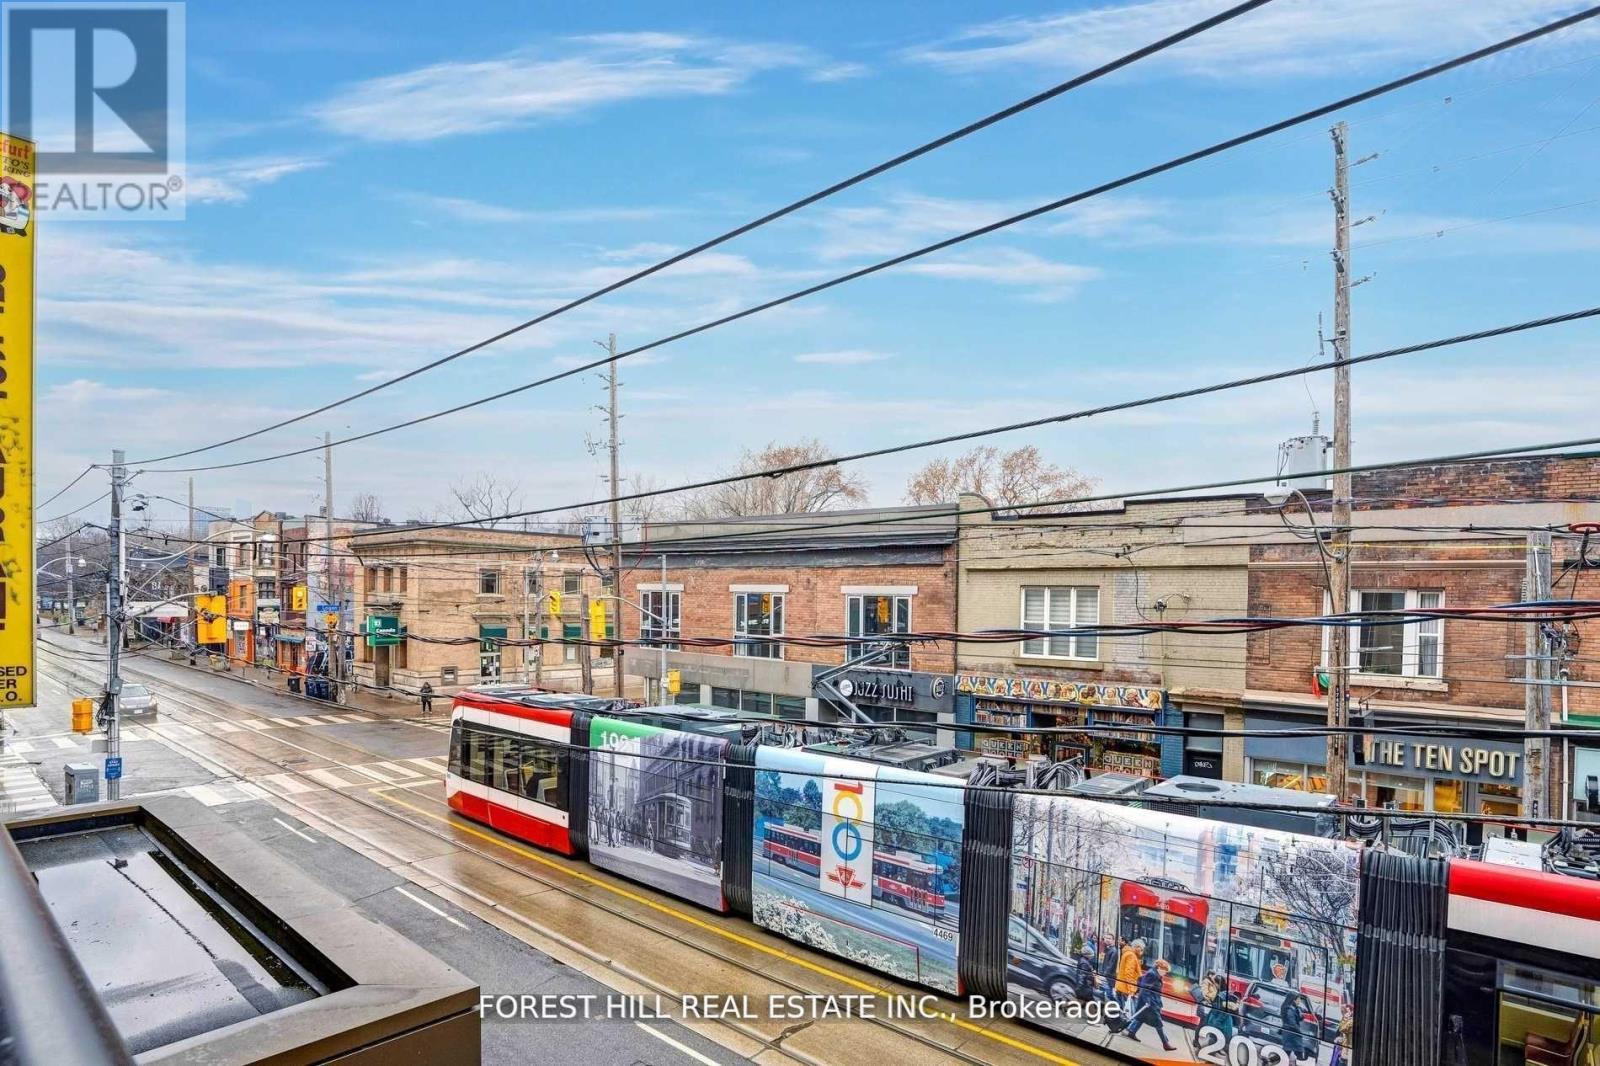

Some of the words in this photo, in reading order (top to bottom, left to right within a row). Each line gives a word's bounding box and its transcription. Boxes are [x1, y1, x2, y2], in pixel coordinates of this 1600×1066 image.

[1370, 739, 1405, 766] THE
[1412, 743, 1453, 772] TEN
[1459, 747, 1521, 779] SPOT
[933, 928, 953, 942] 4469
[1198, 1026, 1297, 1066] 202
